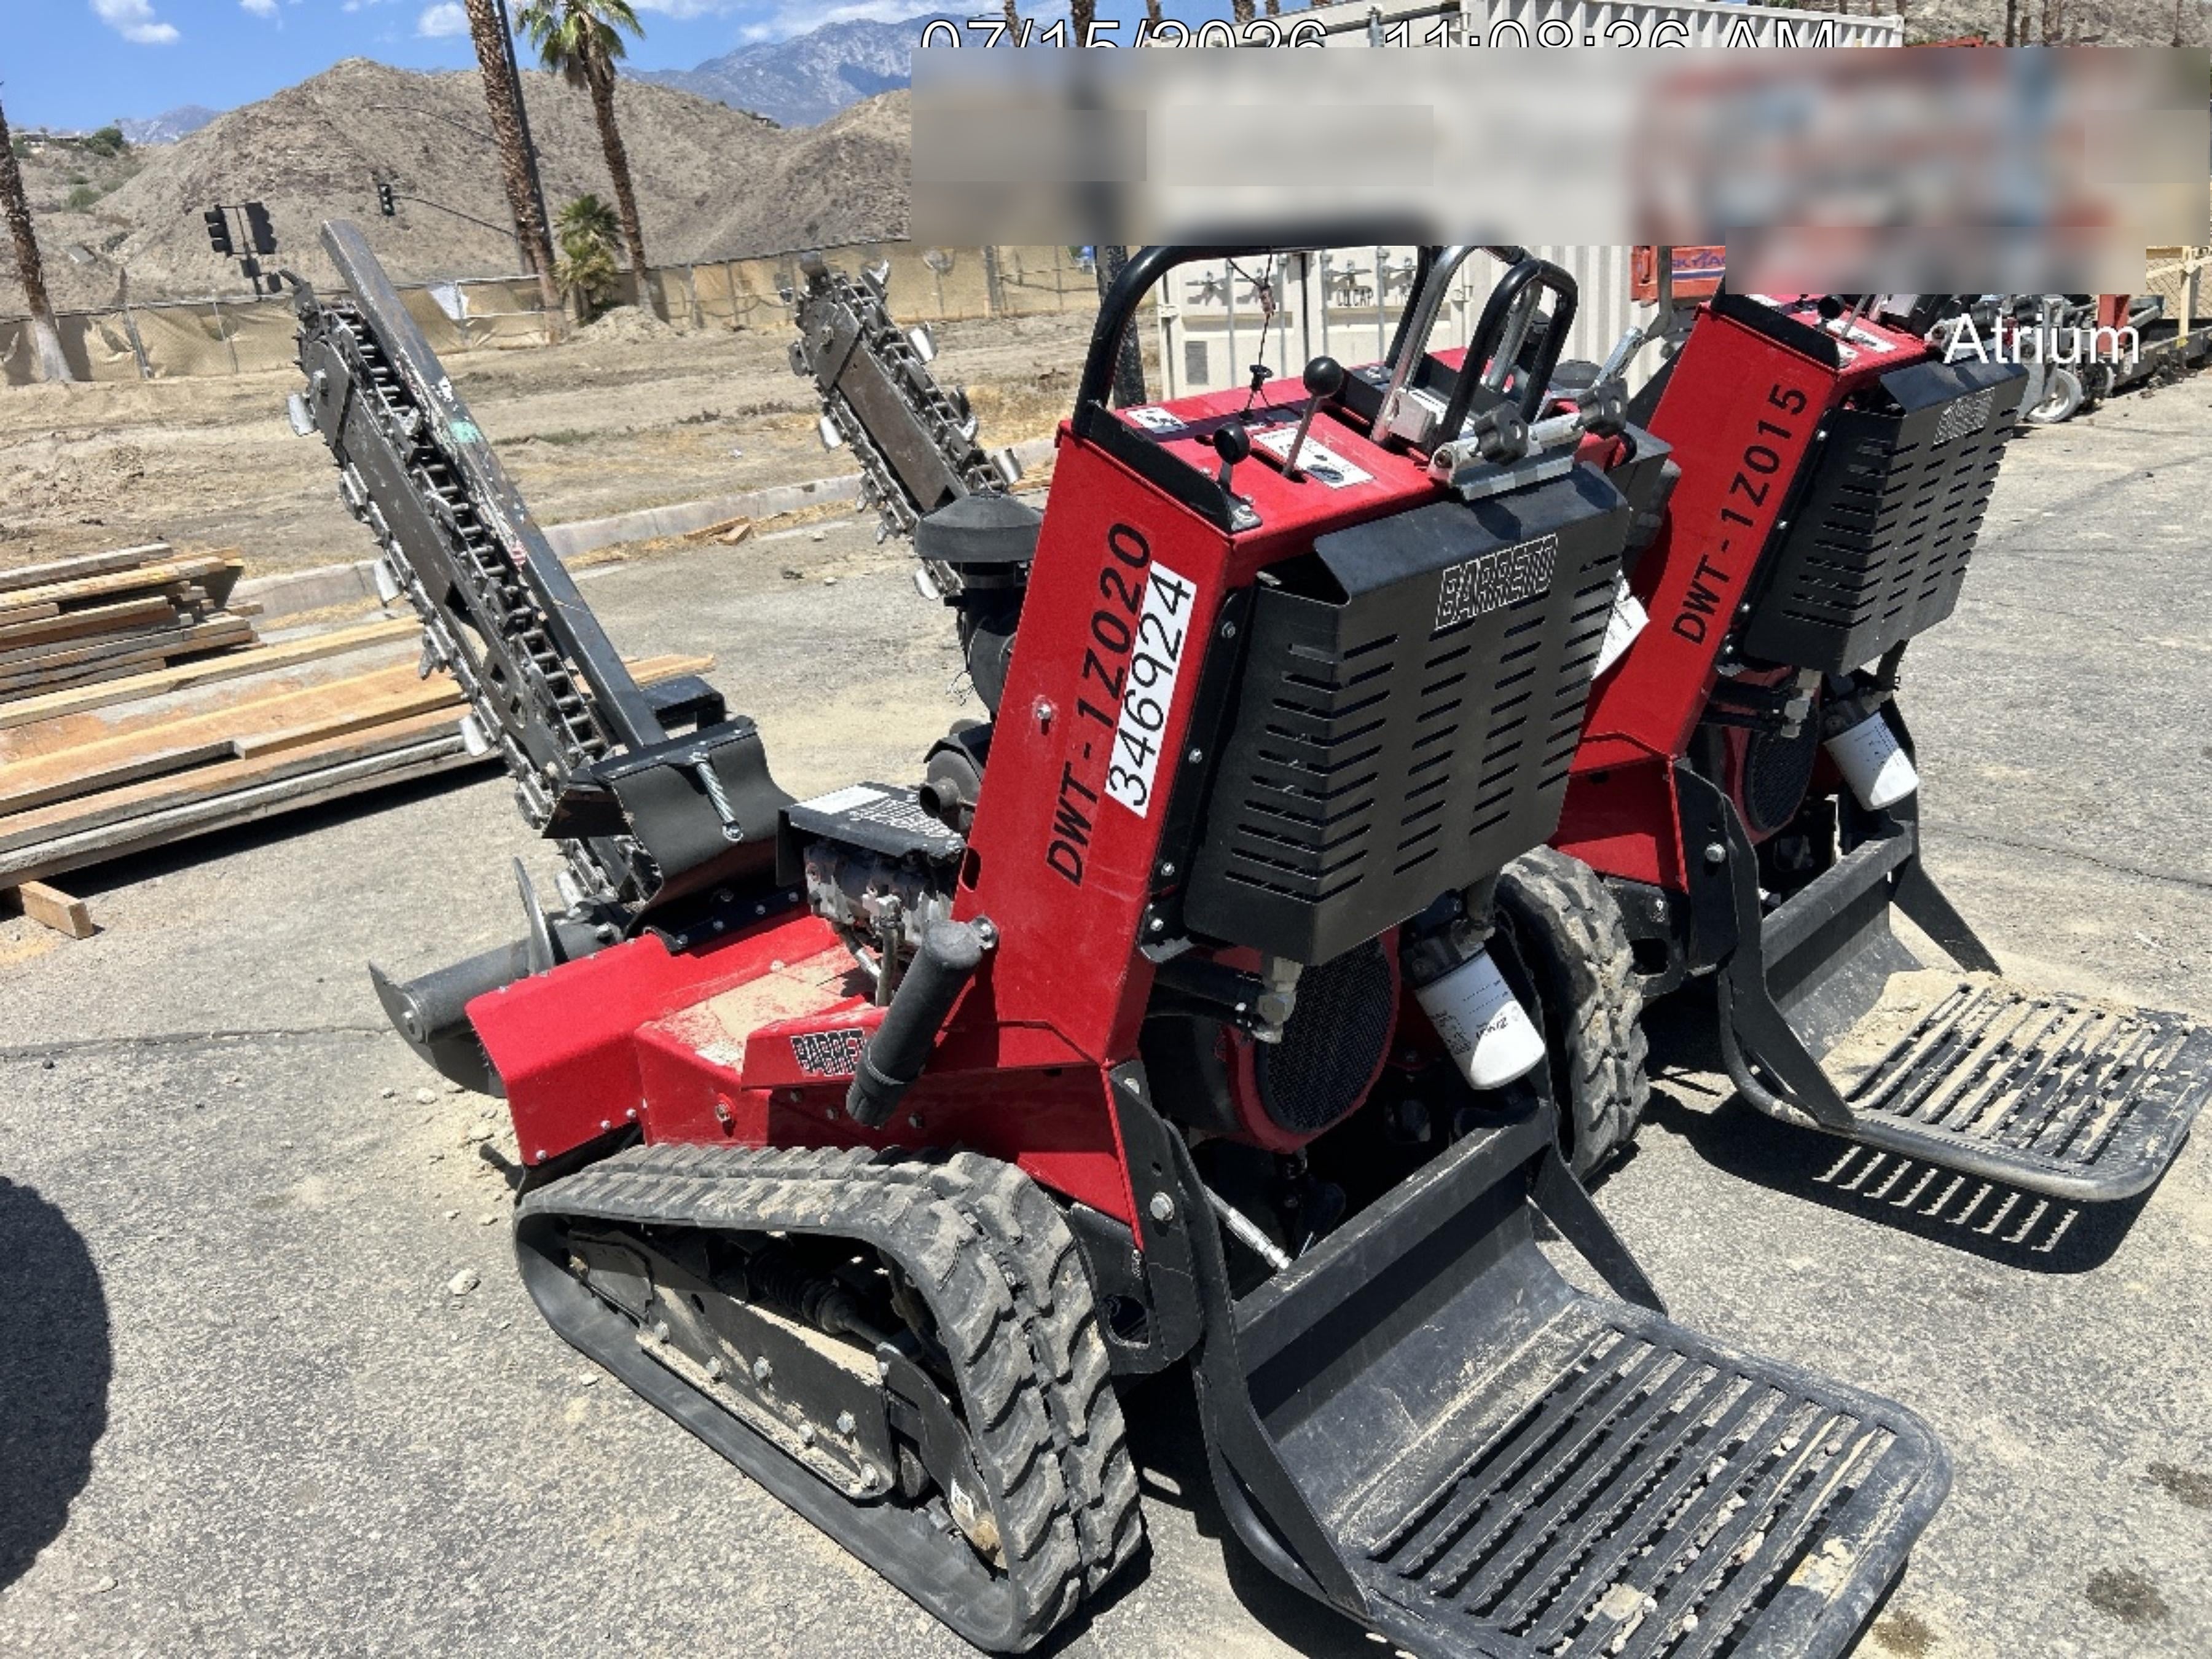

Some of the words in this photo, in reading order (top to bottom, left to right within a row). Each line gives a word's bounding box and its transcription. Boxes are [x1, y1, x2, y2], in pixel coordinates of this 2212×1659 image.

[1671, 384, 1807, 645] DWT-1Z015
[1046, 522, 1150, 885] DWT-1Z020
[1108, 572, 1191, 807] 346924
